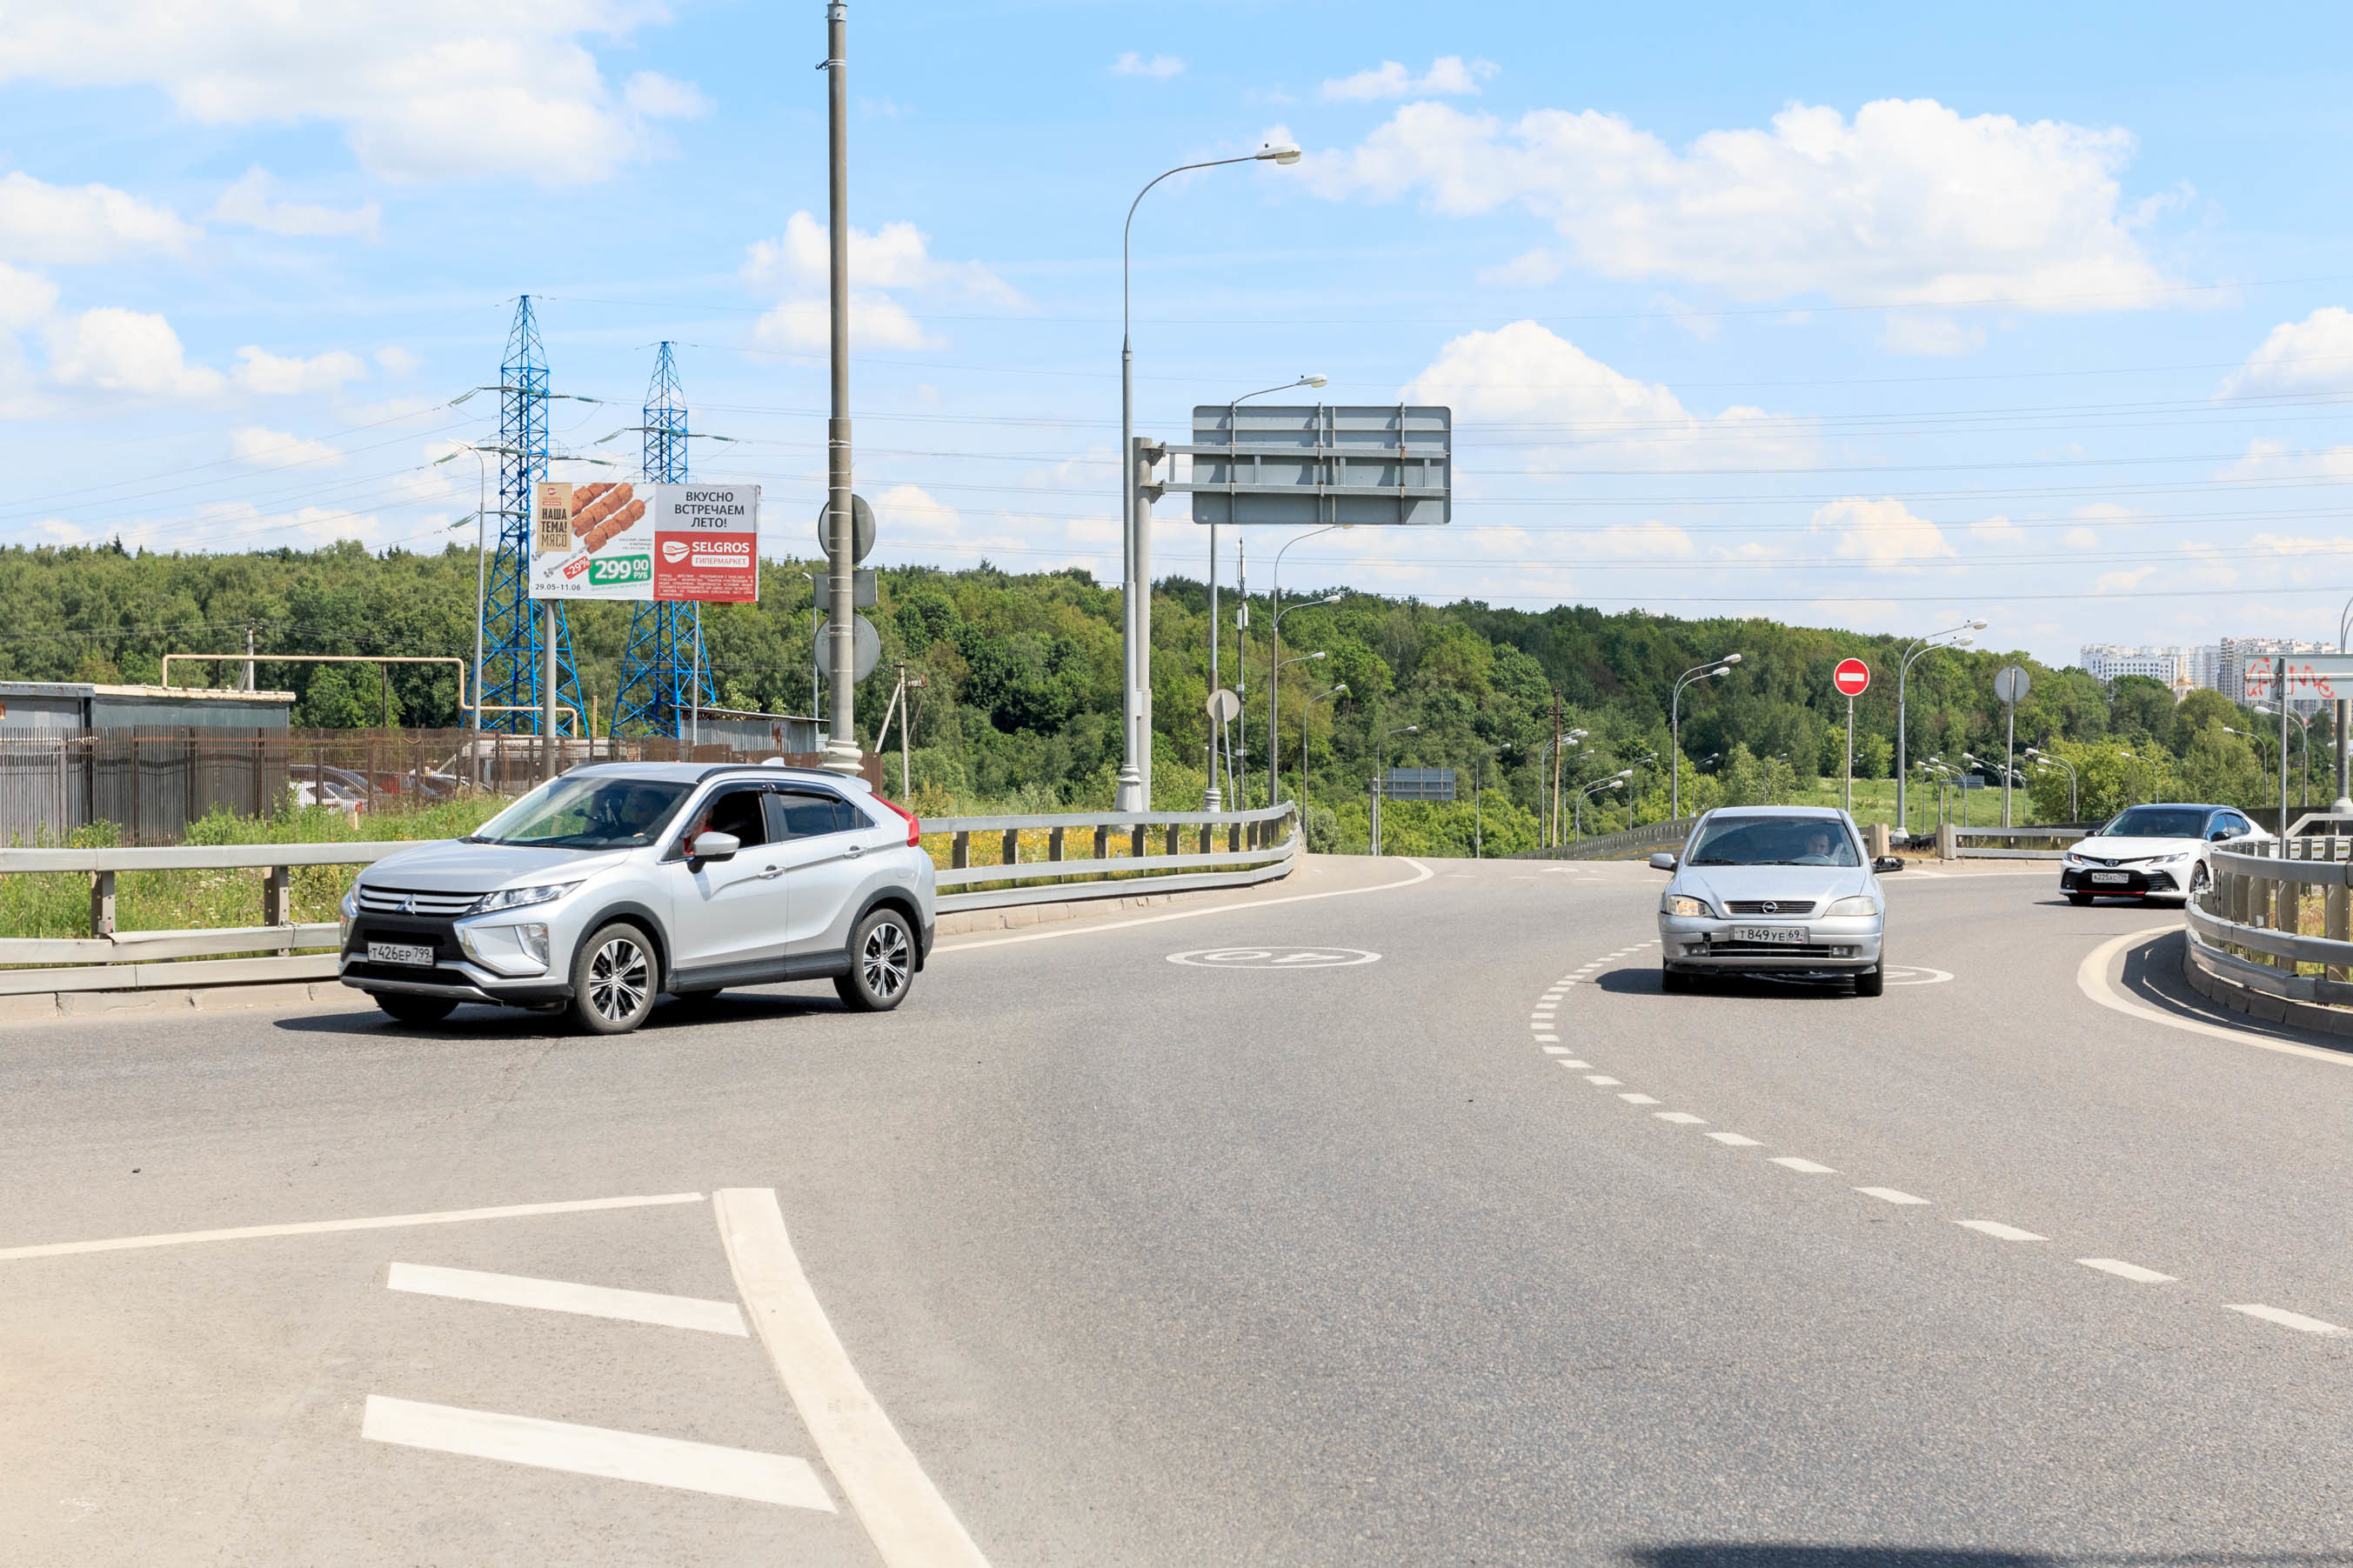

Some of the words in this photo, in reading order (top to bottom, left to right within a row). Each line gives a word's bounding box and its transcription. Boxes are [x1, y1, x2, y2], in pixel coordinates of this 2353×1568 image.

[686, 491, 733, 502] ВКУСНО
[542, 508, 567, 520] НАША
[675, 504, 745, 515] ВСТРЕЧАЕМ
[541, 521, 567, 533] ТЕМА!
[691, 517, 727, 528] ЛЕТО!
[541, 534, 567, 547] МЯСО
[692, 541, 750, 553] SELGROS
[566, 557, 590, 575] -29%
[595, 560, 632, 579] 299
[632, 558, 649, 570] 00
